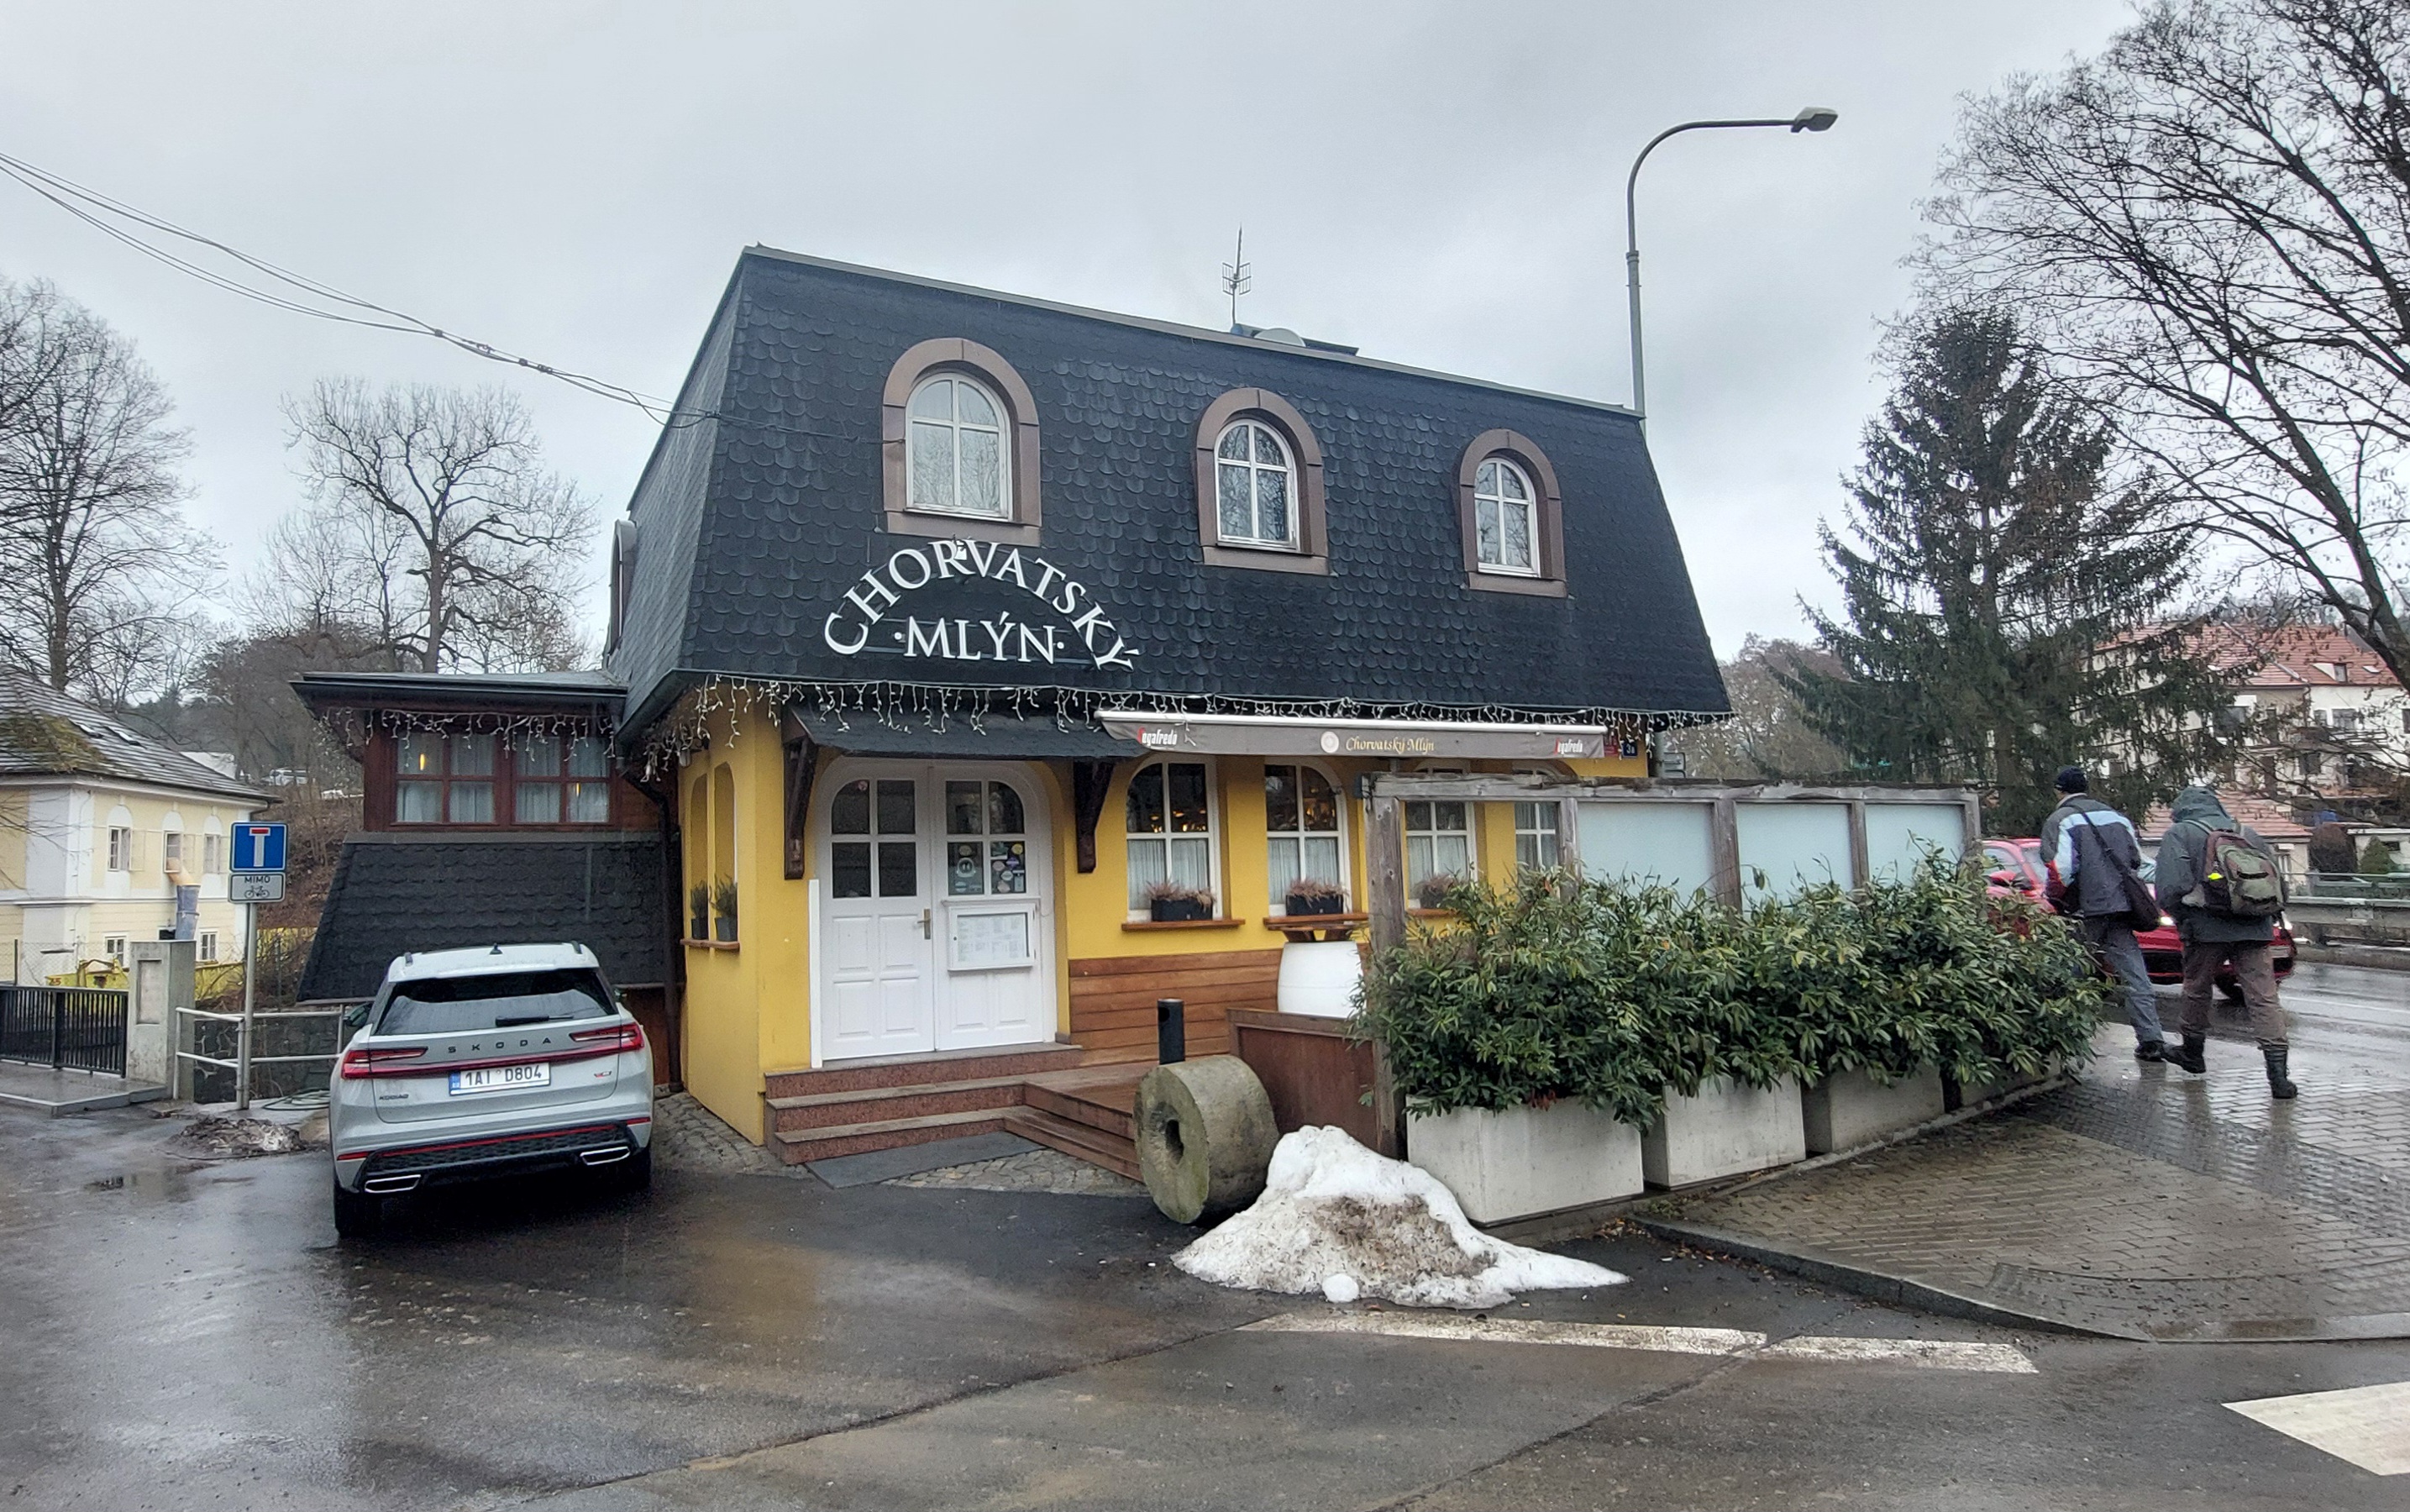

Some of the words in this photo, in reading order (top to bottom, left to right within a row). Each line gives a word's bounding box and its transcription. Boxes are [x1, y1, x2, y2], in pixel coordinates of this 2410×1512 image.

[823, 538, 1141, 671] CHORVATSKÝ
[1346, 736, 1405, 754] Chorvatský
[1406, 738, 1434, 754] Mlýn
[244, 875, 270, 884] MIMO
[505, 1064, 542, 1083] D804
